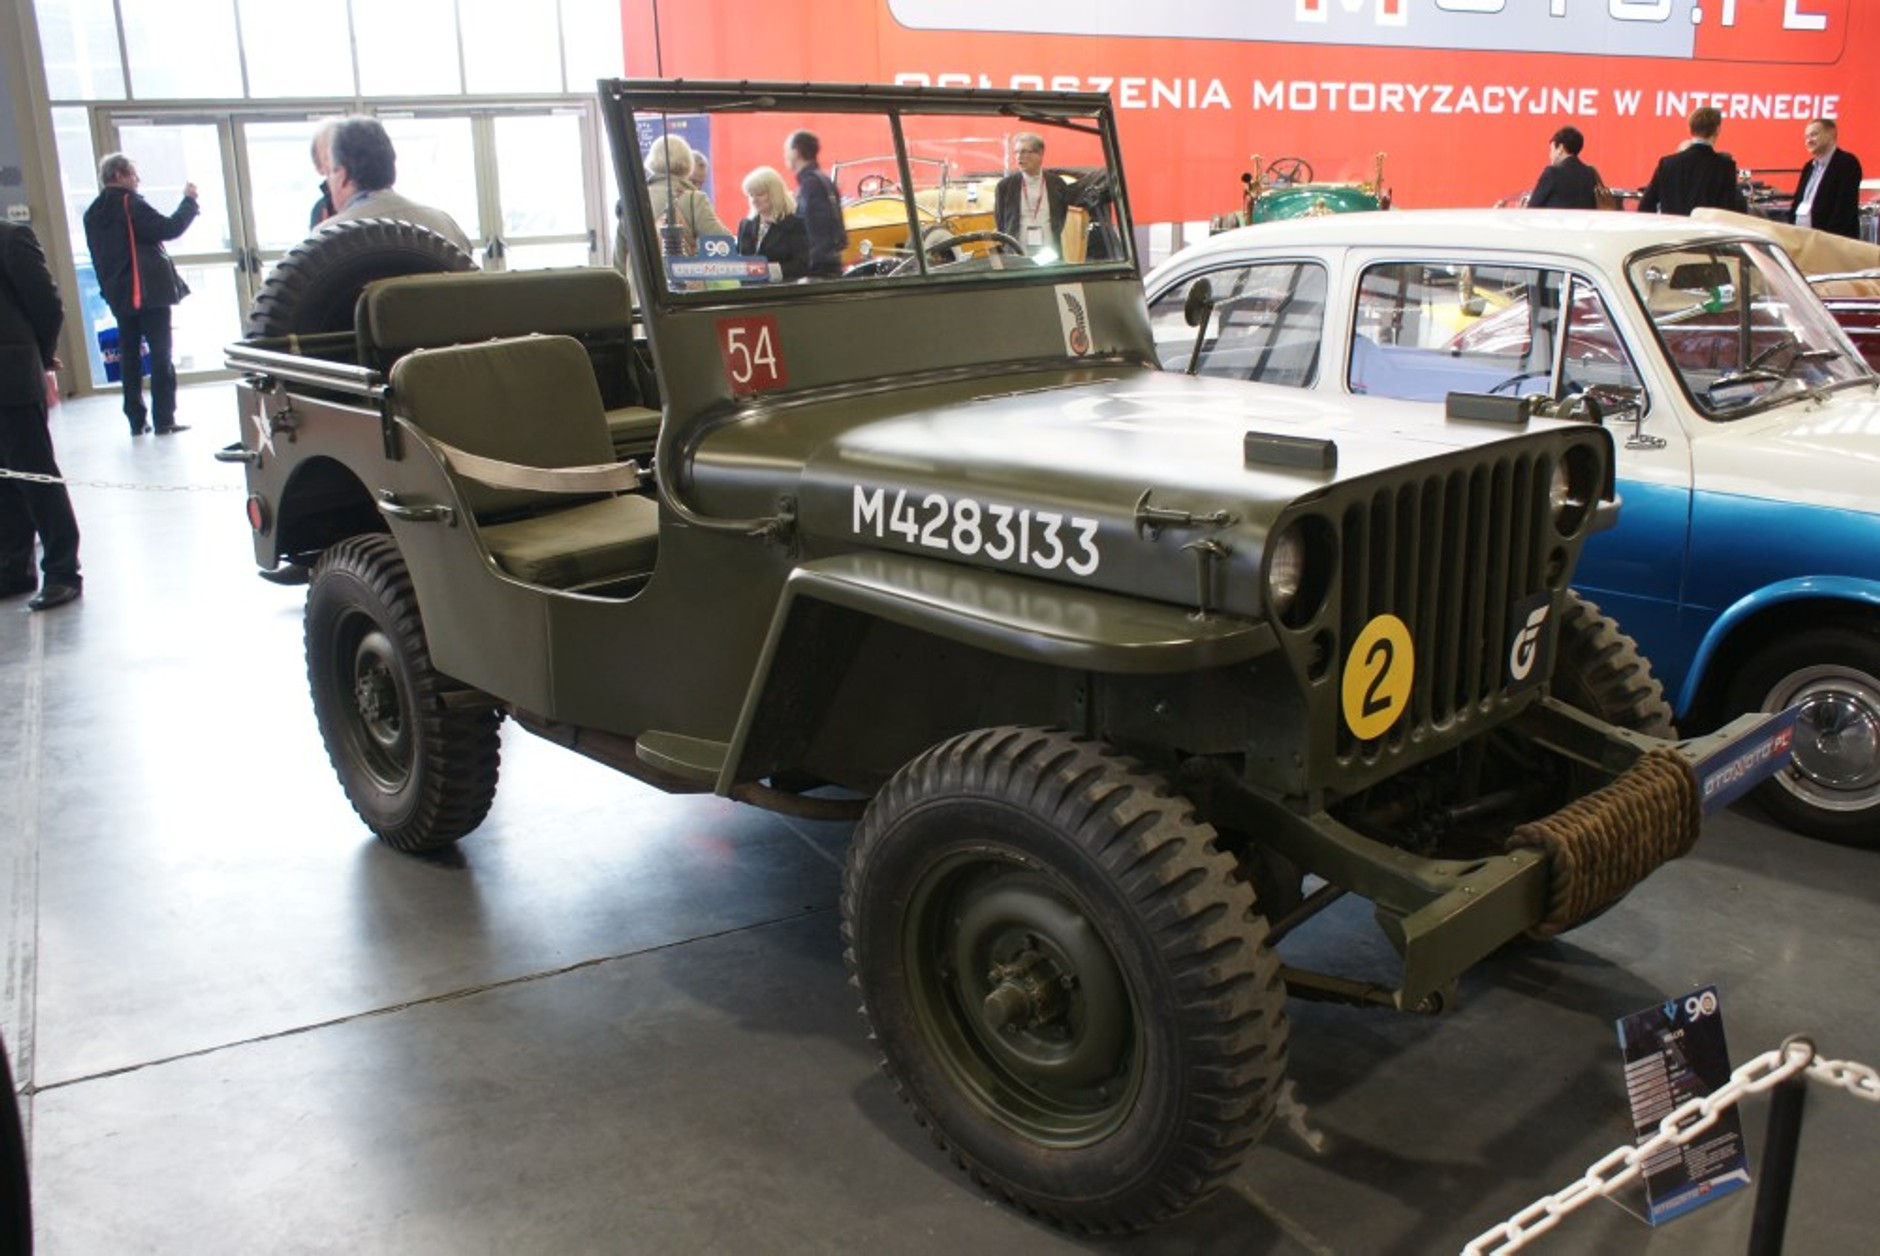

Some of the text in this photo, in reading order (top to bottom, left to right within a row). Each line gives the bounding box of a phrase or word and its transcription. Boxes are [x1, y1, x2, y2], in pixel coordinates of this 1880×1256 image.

[1253, 80, 1599, 116] MOTORYZACYJNE
[1613, 90, 1642, 116] W
[1655, 90, 1840, 119] INTERNECIE
[728, 326, 778, 383] 54
[853, 485, 1100, 576] M4283133
[1361, 637, 1394, 719] 2
[1684, 991, 1717, 1022] 90
